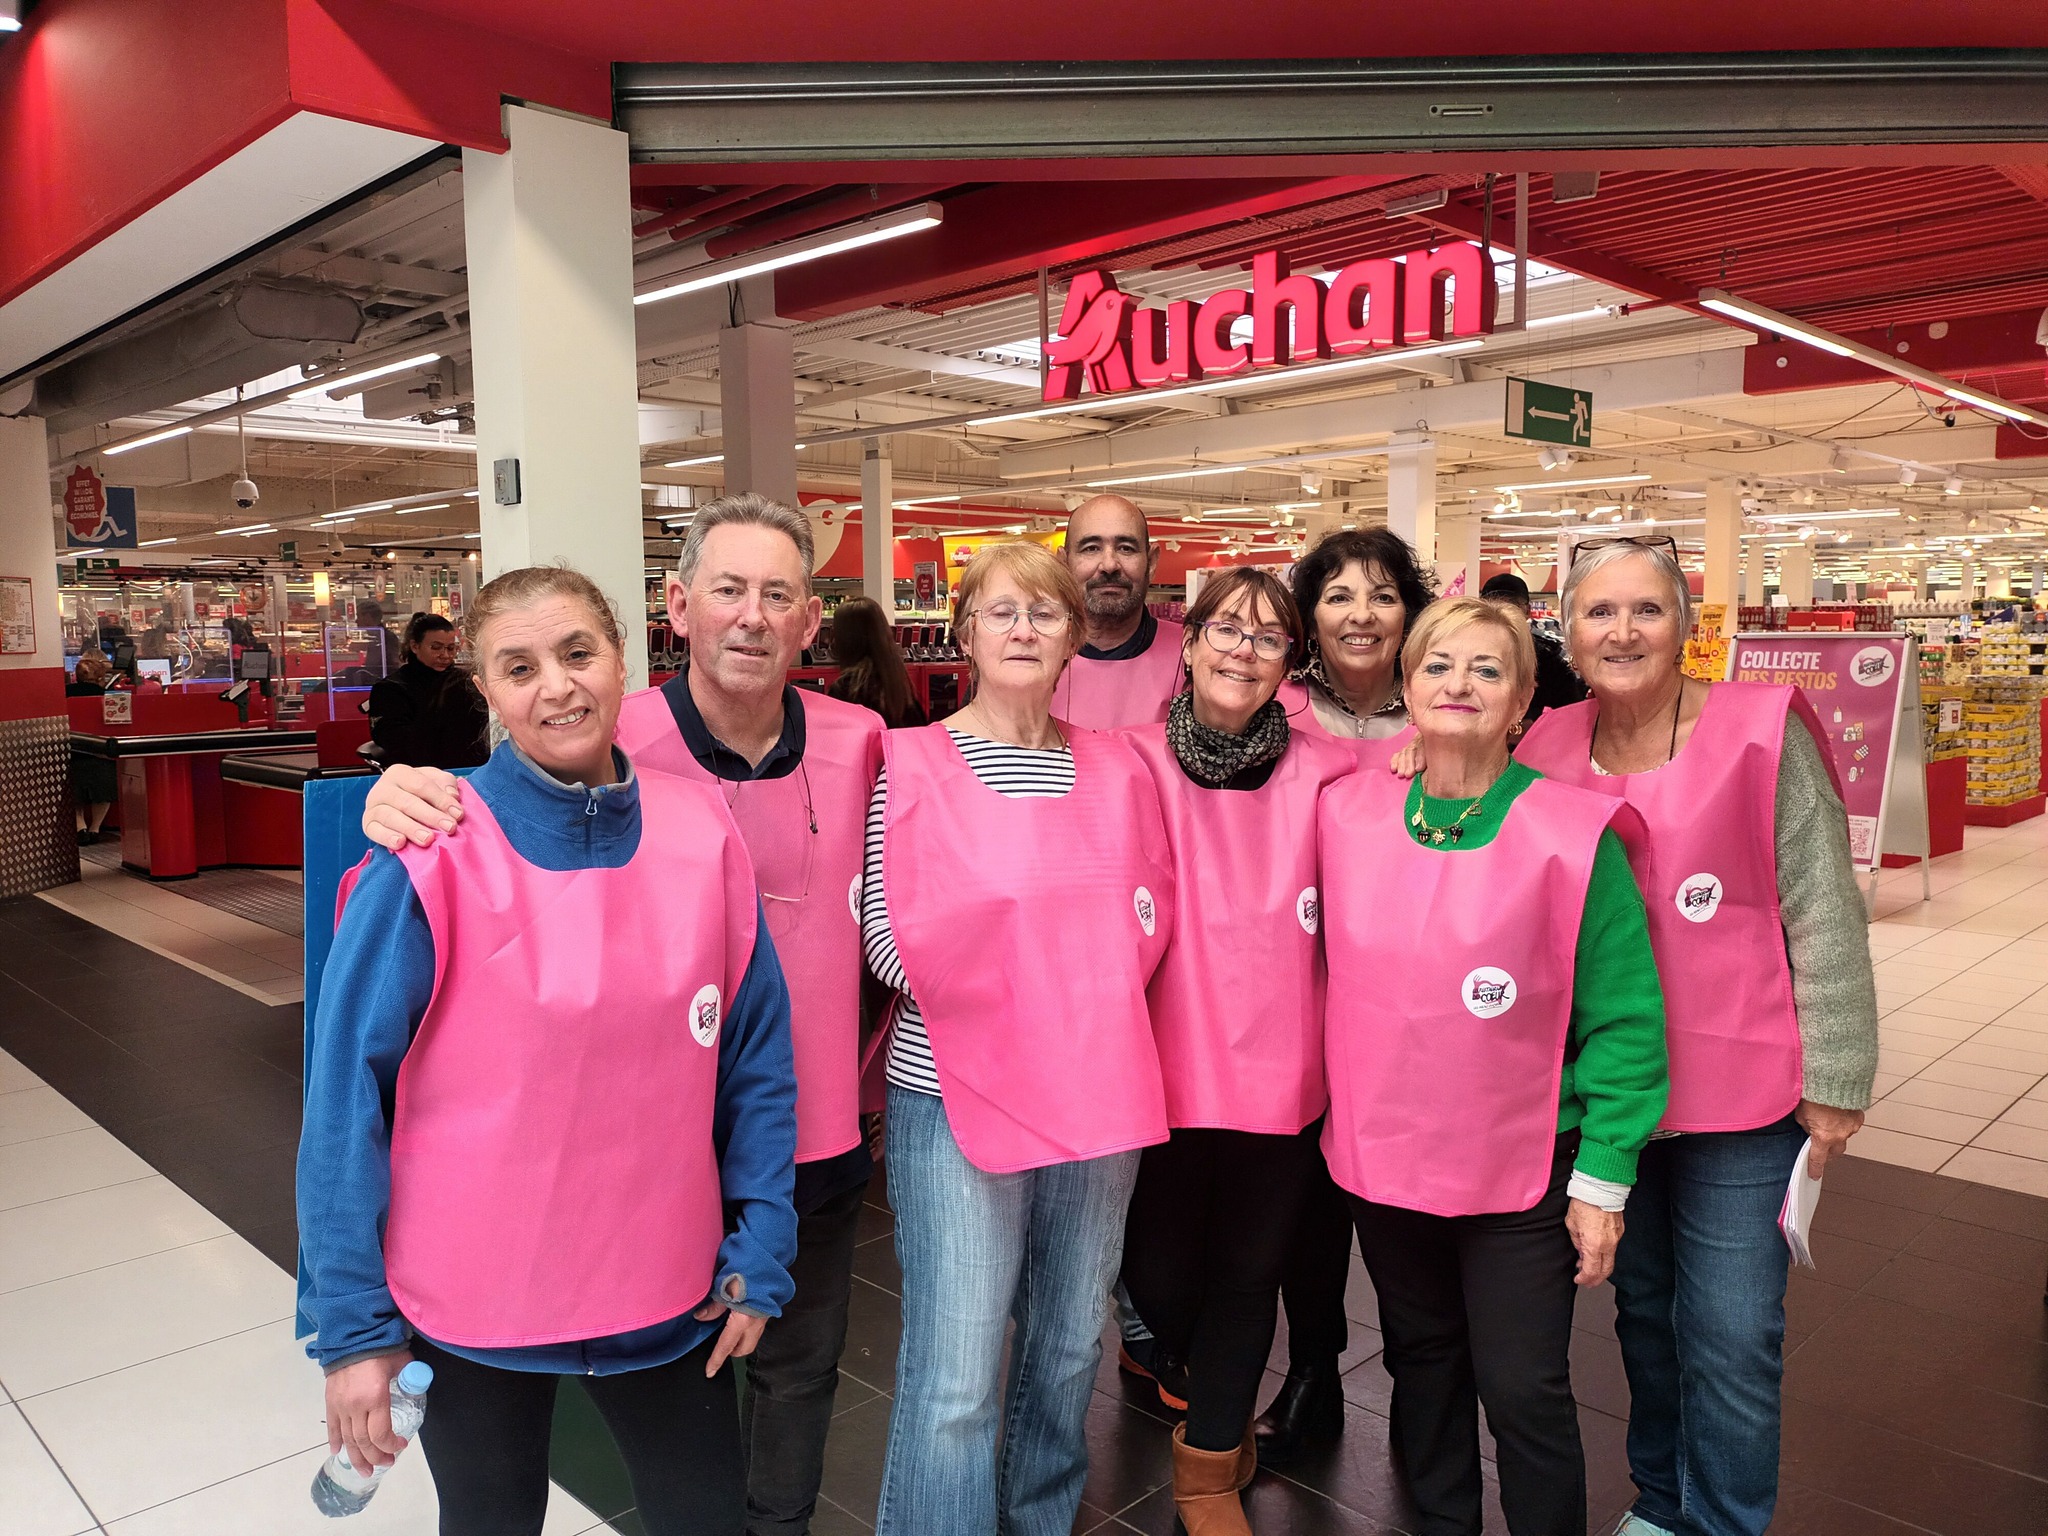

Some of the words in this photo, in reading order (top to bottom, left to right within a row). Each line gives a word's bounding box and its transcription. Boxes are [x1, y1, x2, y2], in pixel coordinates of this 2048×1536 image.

[1042, 241, 1495, 402] Auchan
[1740, 651, 1821, 670] COLLECTE
[1738, 670, 1769, 683] DES
[1773, 671, 1838, 690] RESTOS
